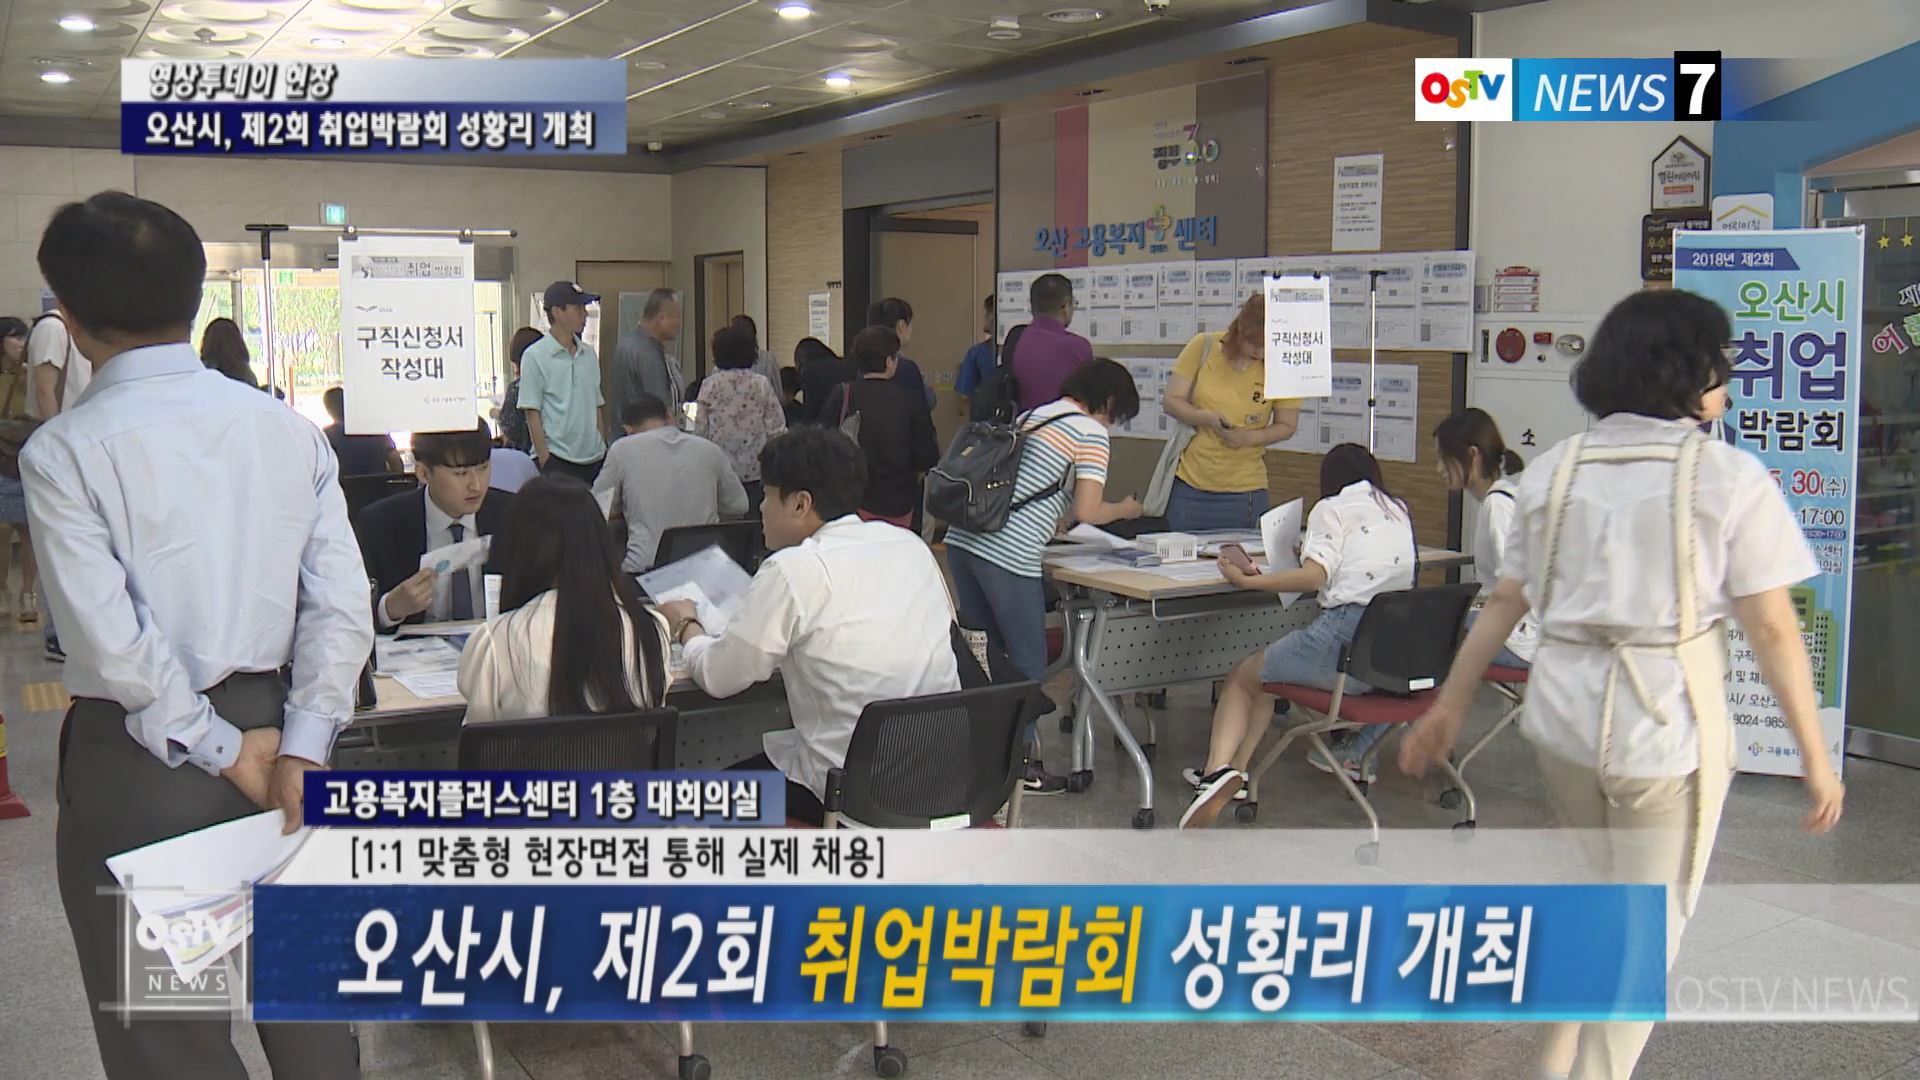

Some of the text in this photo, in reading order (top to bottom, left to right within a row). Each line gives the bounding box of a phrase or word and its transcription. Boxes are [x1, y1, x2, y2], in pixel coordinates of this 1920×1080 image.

[1033, 215, 1217, 257] 오산 고용복지 센터
[1691, 251, 1736, 267] 2018년
[1741, 251, 1775, 267] 제2회
[1735, 280, 1845, 322] 오산시
[357, 325, 463, 349] 구직신청서
[1272, 330, 1323, 347] 구직신청서
[381, 356, 444, 381] 작성대
[1282, 350, 1312, 366] 작성대
[1729, 331, 1847, 401] 취업
[1739, 410, 1844, 451] 박람회
[1791, 470, 1847, 496] 30(수)
